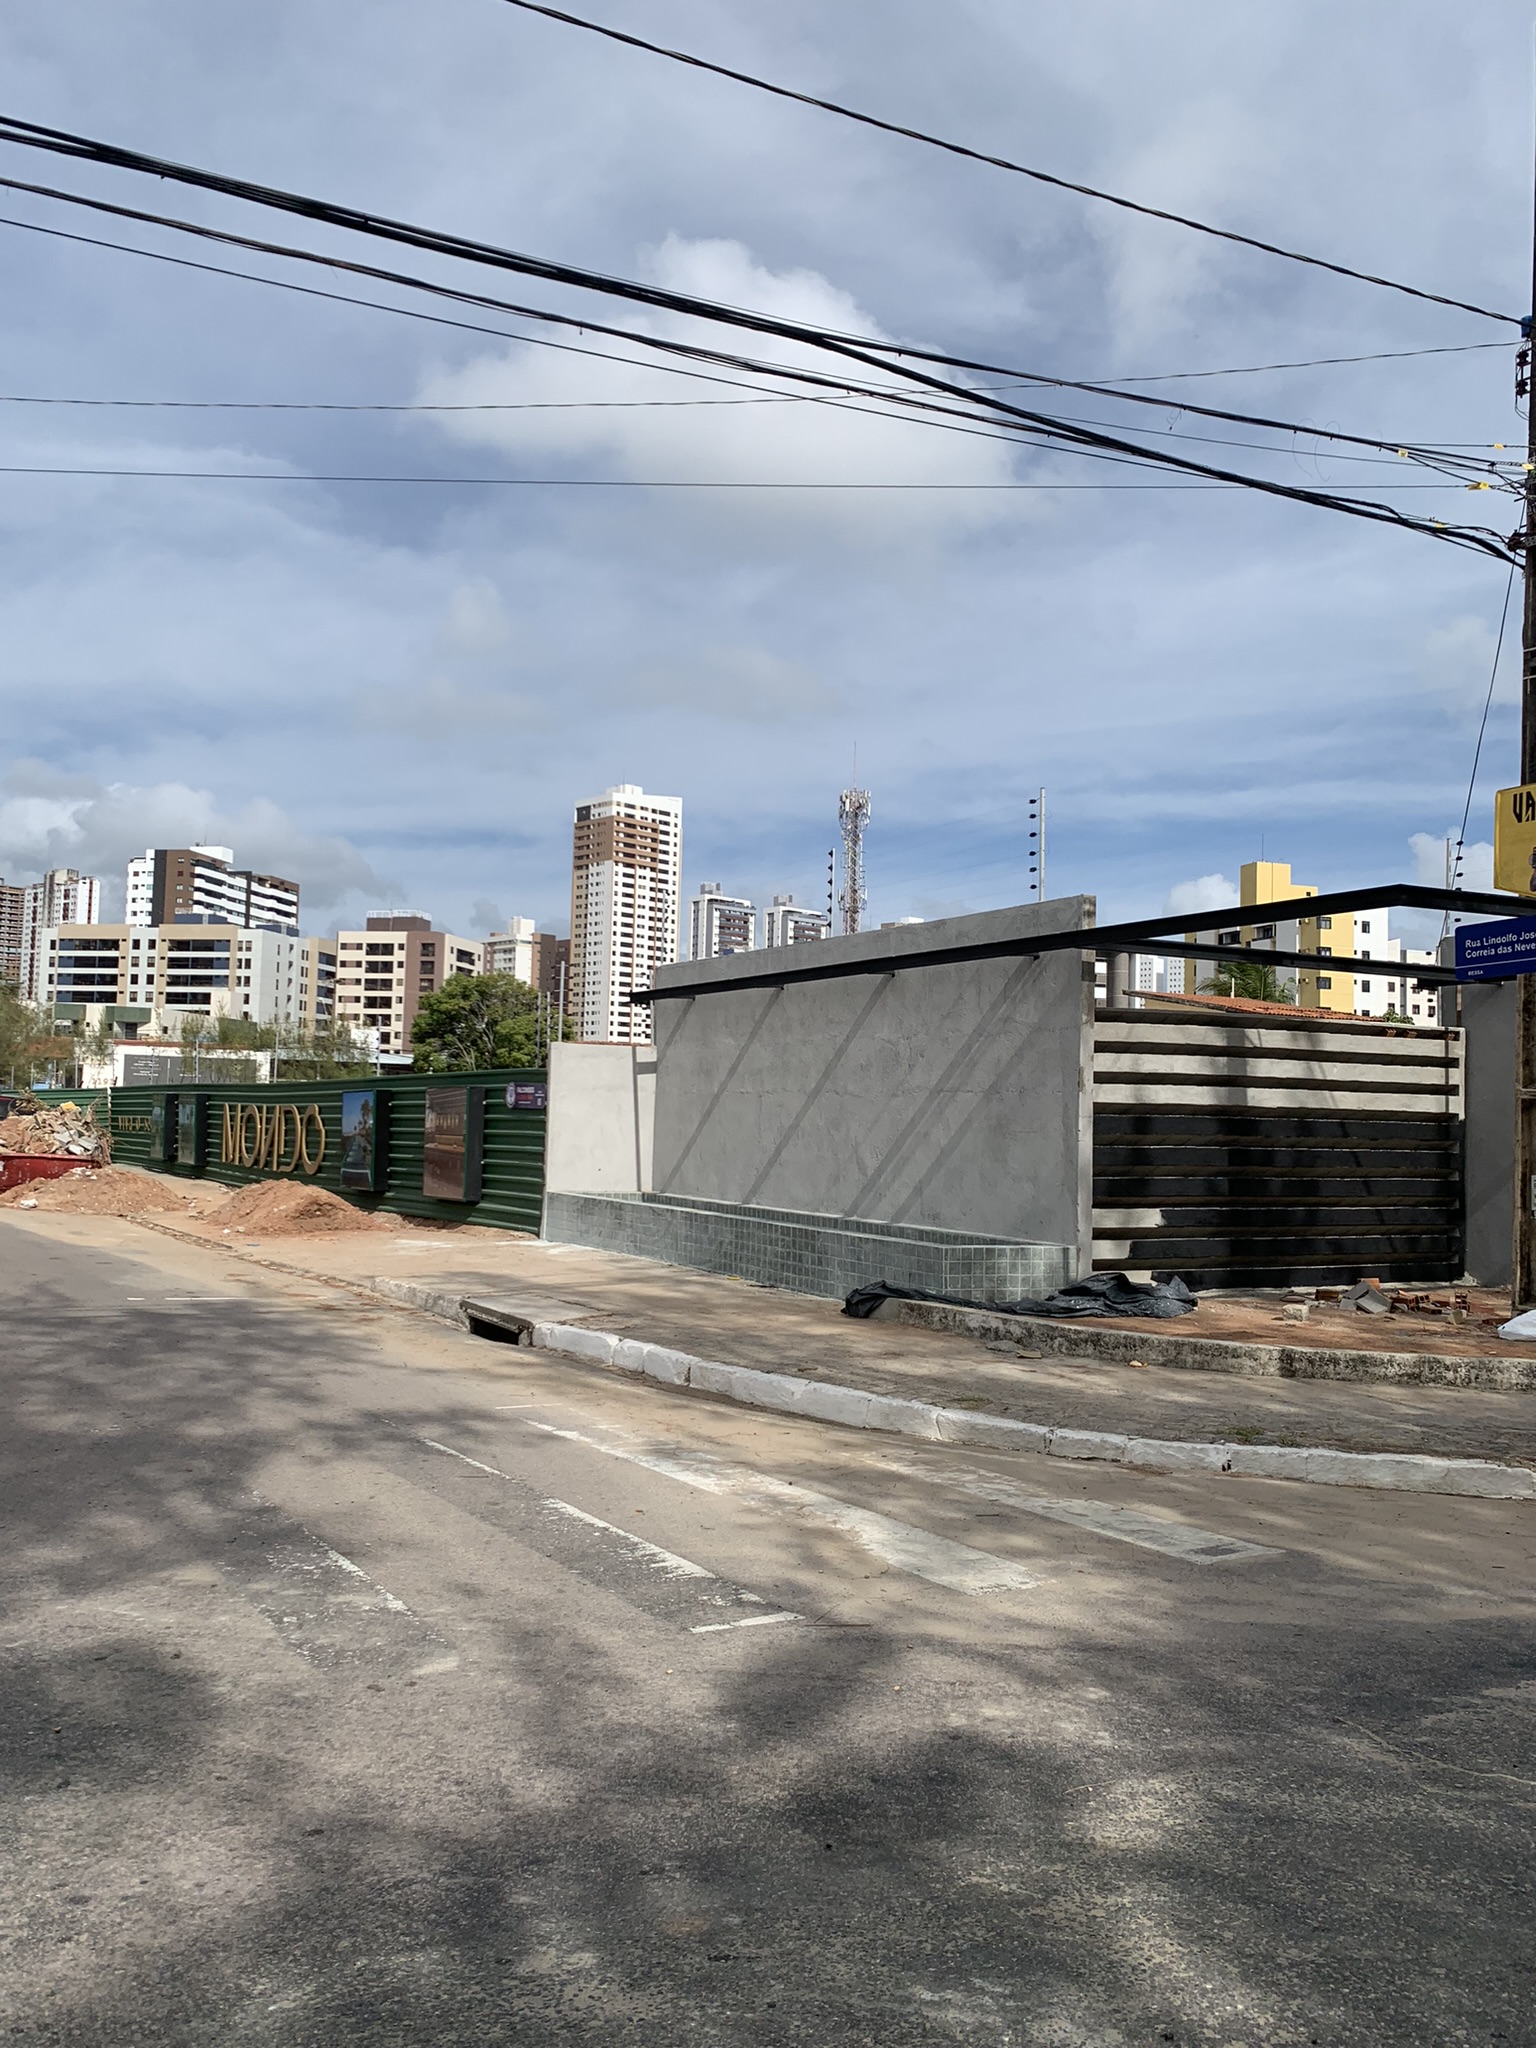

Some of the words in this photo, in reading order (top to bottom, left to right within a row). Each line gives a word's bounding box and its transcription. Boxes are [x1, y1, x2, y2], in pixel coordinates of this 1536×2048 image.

[1465, 939, 1481, 948] Rua
[1483, 933, 1518, 946] Lindolfo
[1519, 931, 1536, 941] Jos
[1465, 946, 1495, 959] Correia
[1497, 945, 1512, 954] das
[1514, 942, 1536, 952] Neve
